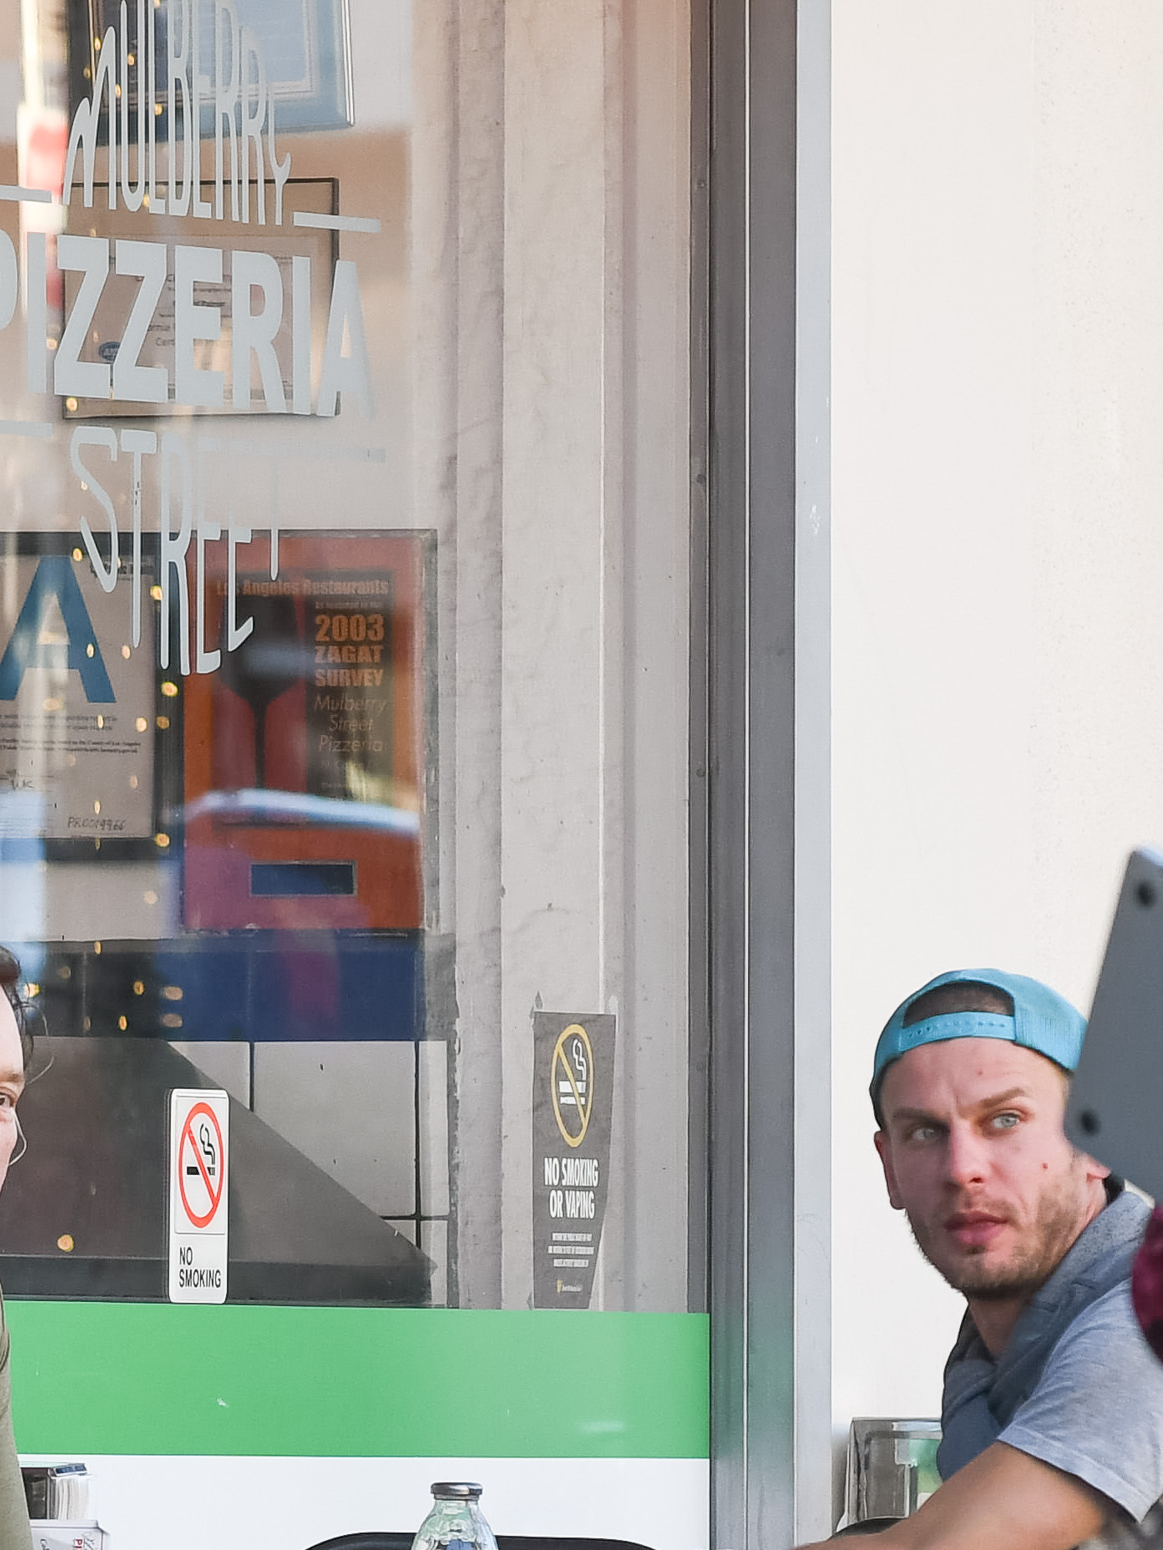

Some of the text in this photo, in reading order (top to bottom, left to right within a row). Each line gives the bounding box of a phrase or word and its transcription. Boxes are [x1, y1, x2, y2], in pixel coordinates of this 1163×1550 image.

[71, 426, 288, 676] STREET
[242, 579, 300, 597] Angeles
[302, 579, 388, 595] Restaurants
[315, 613, 384, 642] 2003
[314, 645, 384, 664] ZAGAT
[314, 668, 384, 687] SURVEY
[313, 693, 388, 716] Mulberry
[318, 734, 384, 753] Pizzeria
[544, 1157, 599, 1187] NO SMOKING
[549, 1189, 595, 1219] OR VAPING
[179, 1246, 193, 1266] NO
[178, 1269, 222, 1289] SMOKING
